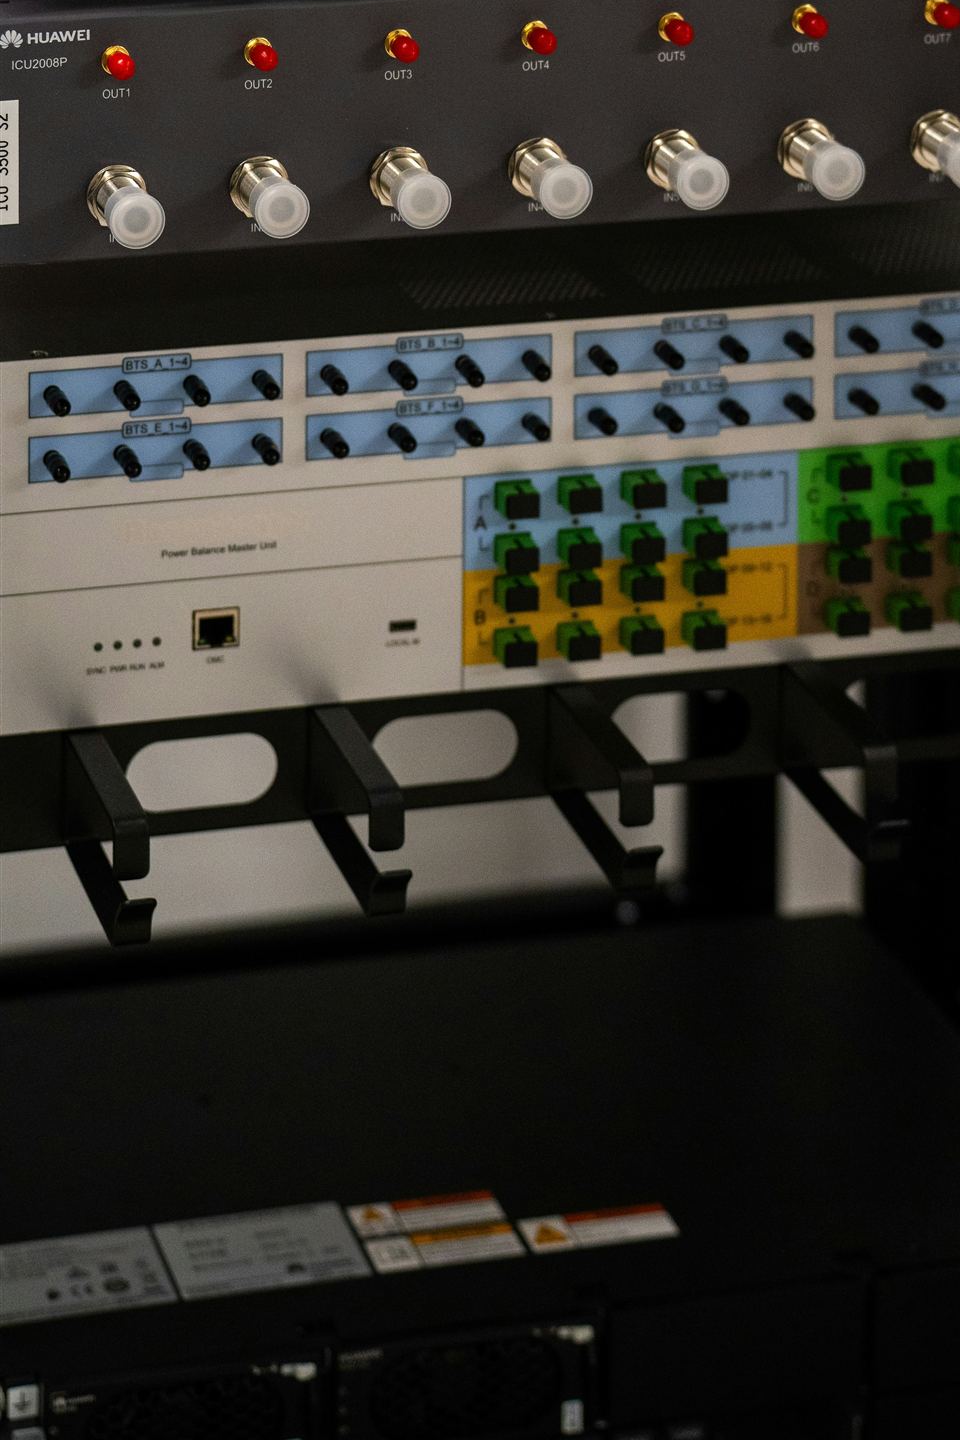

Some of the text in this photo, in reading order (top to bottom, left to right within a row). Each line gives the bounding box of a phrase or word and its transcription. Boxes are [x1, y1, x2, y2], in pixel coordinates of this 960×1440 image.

[27, 29, 90, 44] HUAWEI
[924, 33, 951, 44] OUT7
[792, 42, 820, 53] OUT6
[658, 51, 686, 62] OUT5
[12, 57, 67, 70] ICU2008P
[522, 60, 549, 71] OUT4
[384, 69, 412, 80] OUT3
[244, 79, 272, 90] OUT2
[102, 88, 130, 99] OUT1
[390, 212, 405, 224] IN
[250, 222, 263, 234] IN
[161, 548, 188, 558] Power
[191, 545, 225, 555] Balance
[228, 543, 257, 552] Master
